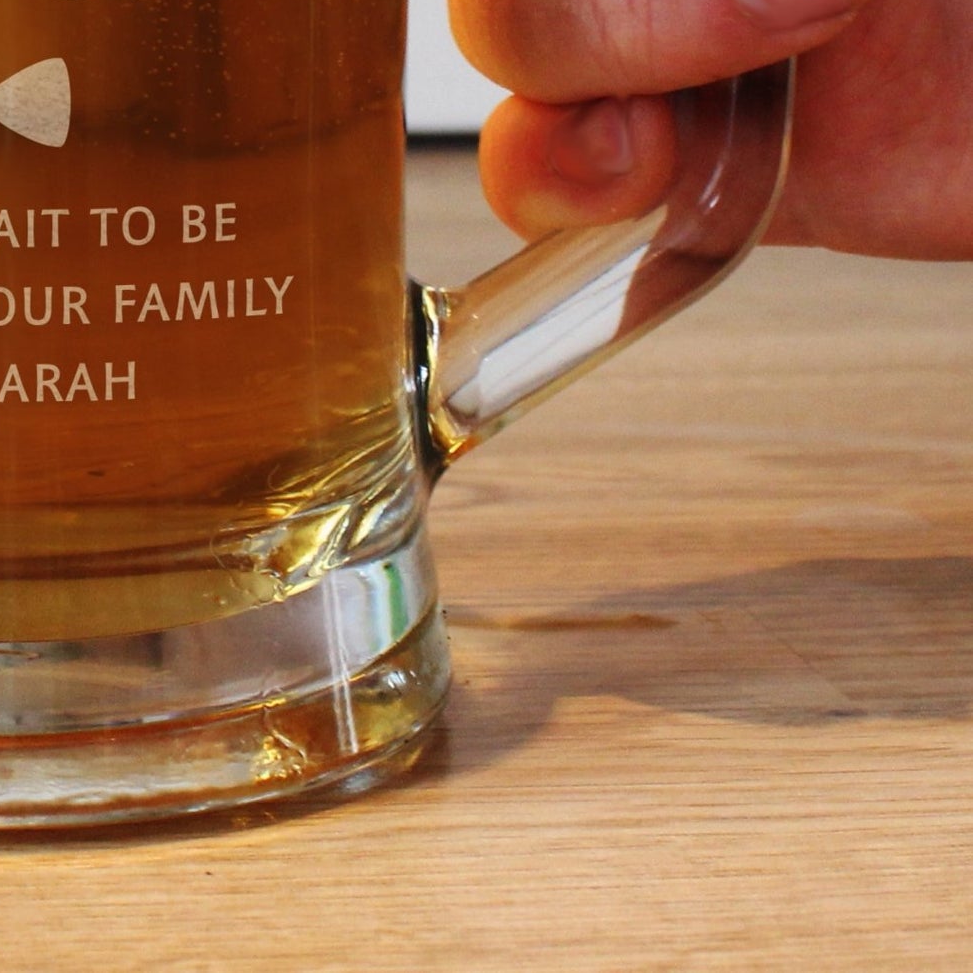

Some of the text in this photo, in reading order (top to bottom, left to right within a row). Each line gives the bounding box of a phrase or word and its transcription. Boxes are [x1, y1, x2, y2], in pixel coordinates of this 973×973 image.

[89, 205, 156, 247] TO
[182, 202, 236, 244] BE
[115, 275, 294, 323] FAMILY
